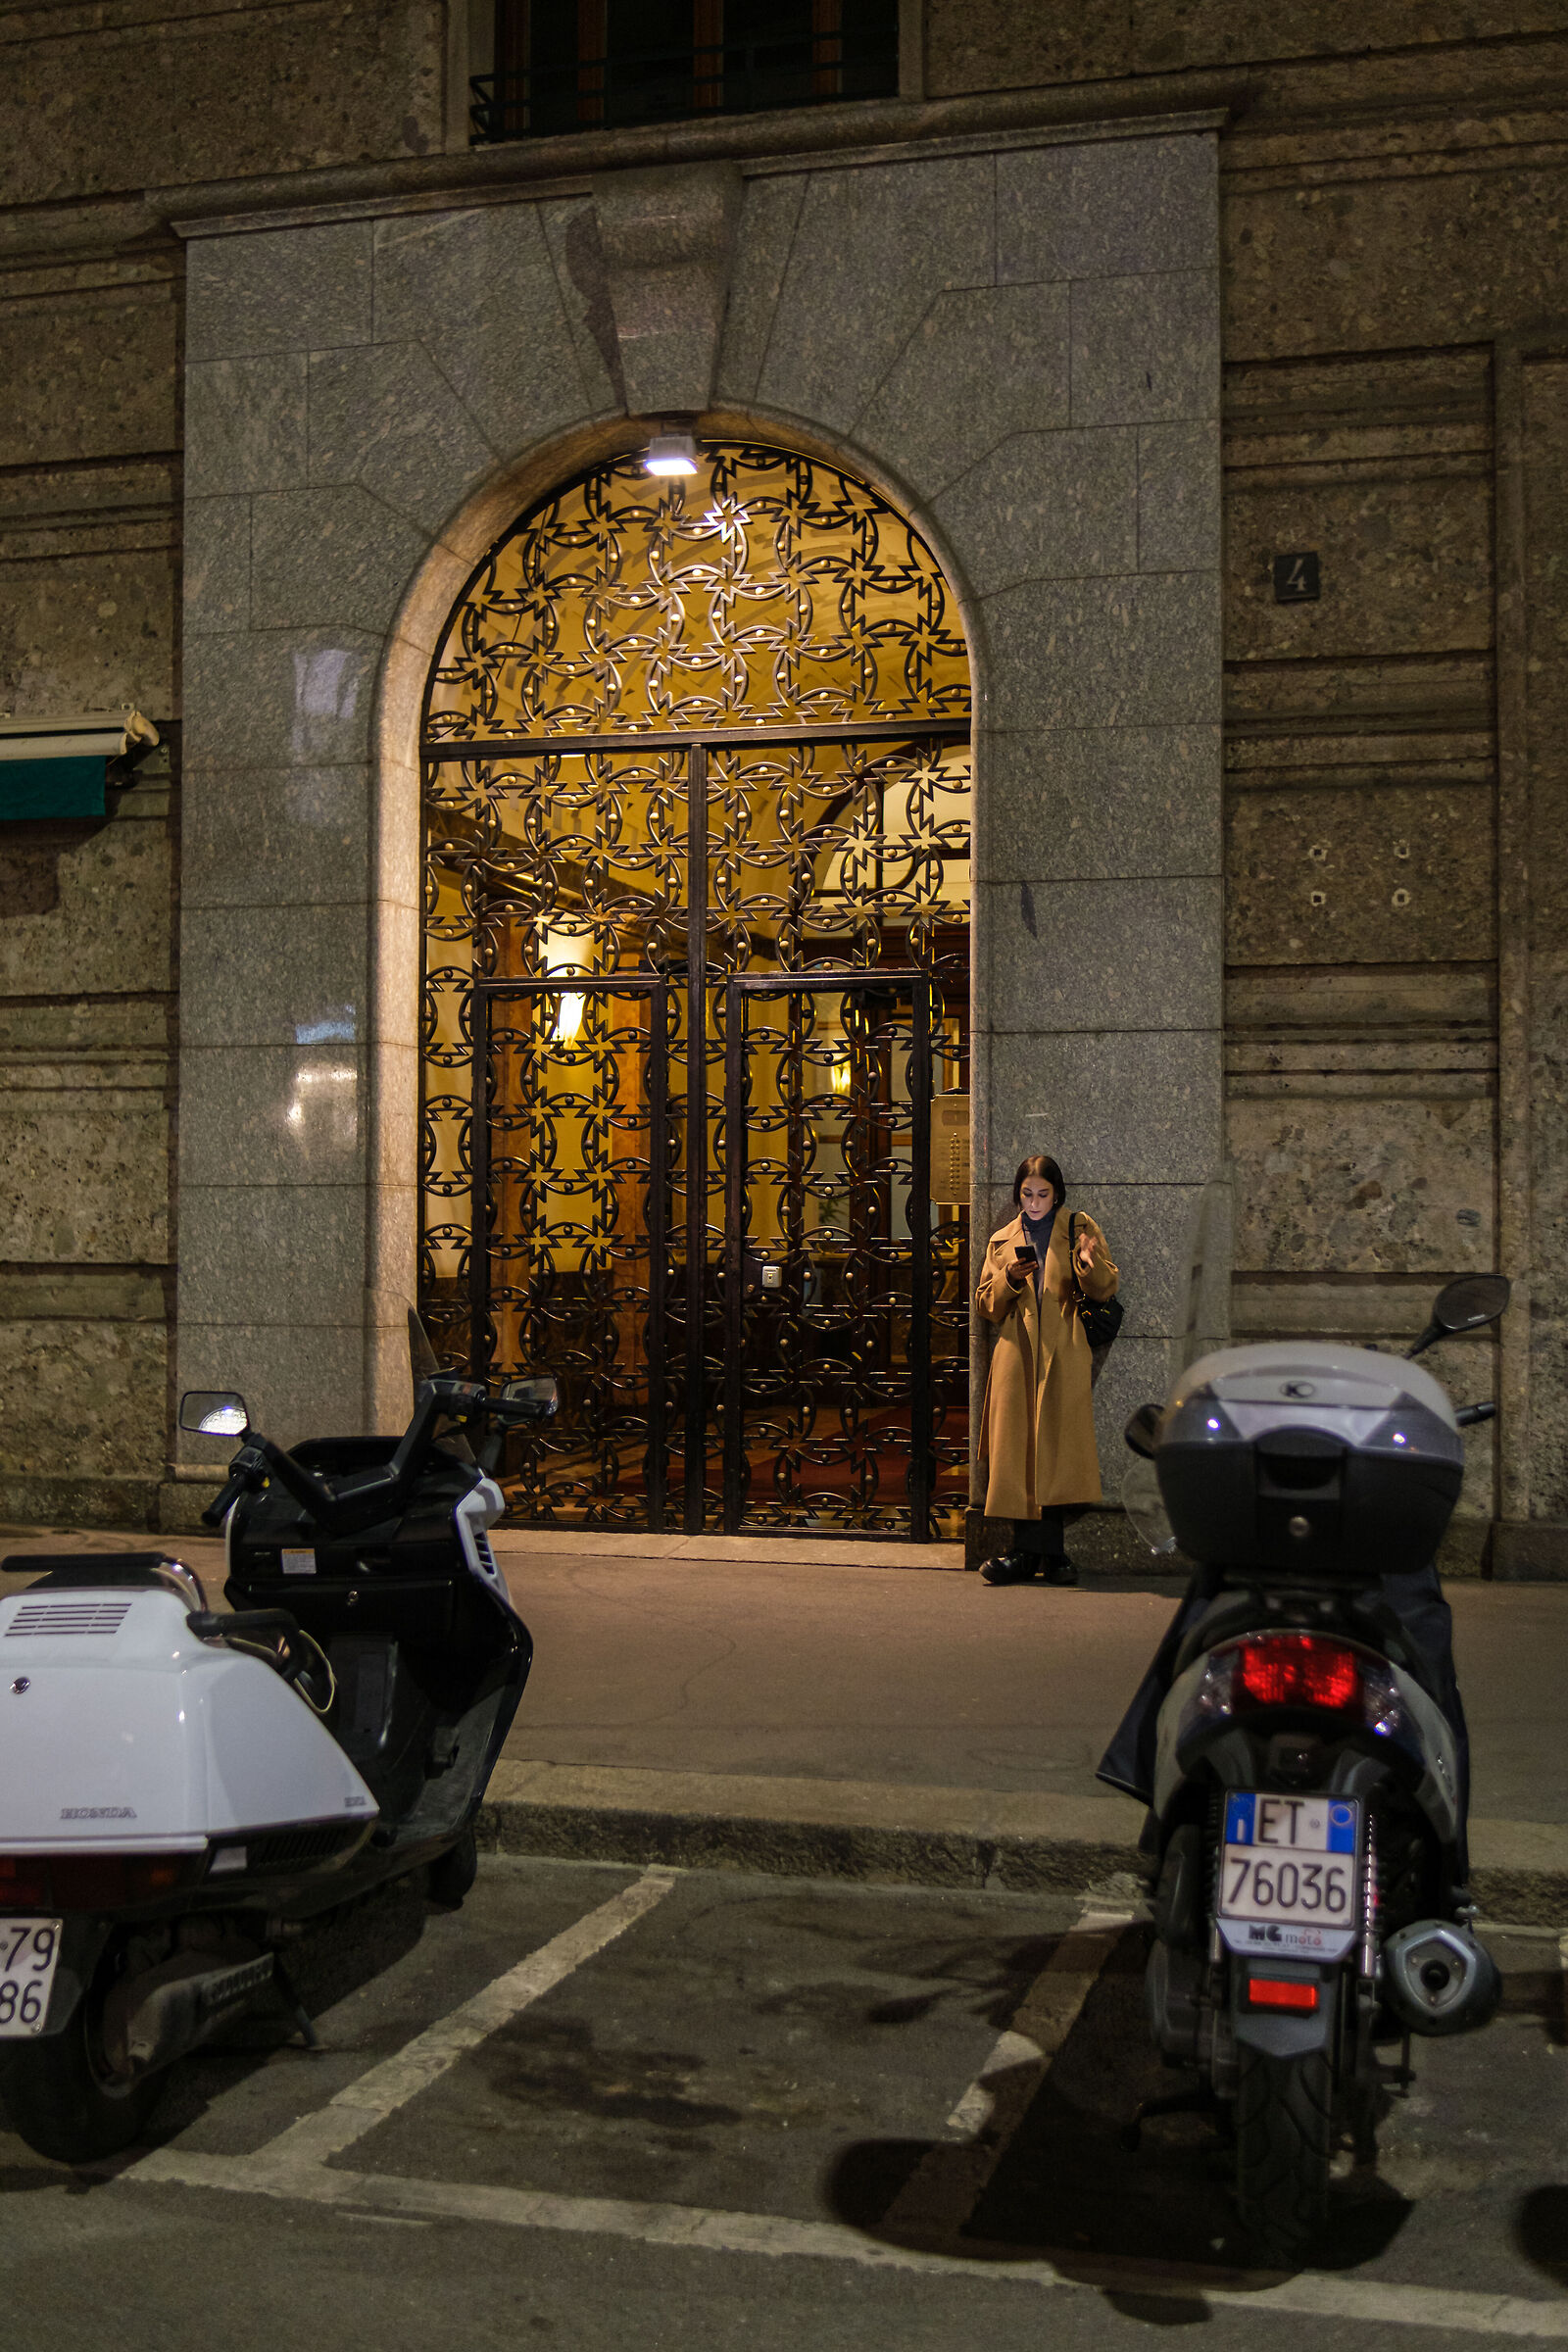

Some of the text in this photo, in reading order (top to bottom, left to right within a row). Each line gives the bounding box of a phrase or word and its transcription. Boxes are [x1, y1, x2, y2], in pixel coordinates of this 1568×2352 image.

[1287, 558, 1306, 591] 4
[60, 1807, 137, 1820] HONDA
[1258, 1797, 1305, 1844] ET
[1228, 1857, 1347, 1913] 76036
[5, 1927, 55, 1972] 79
